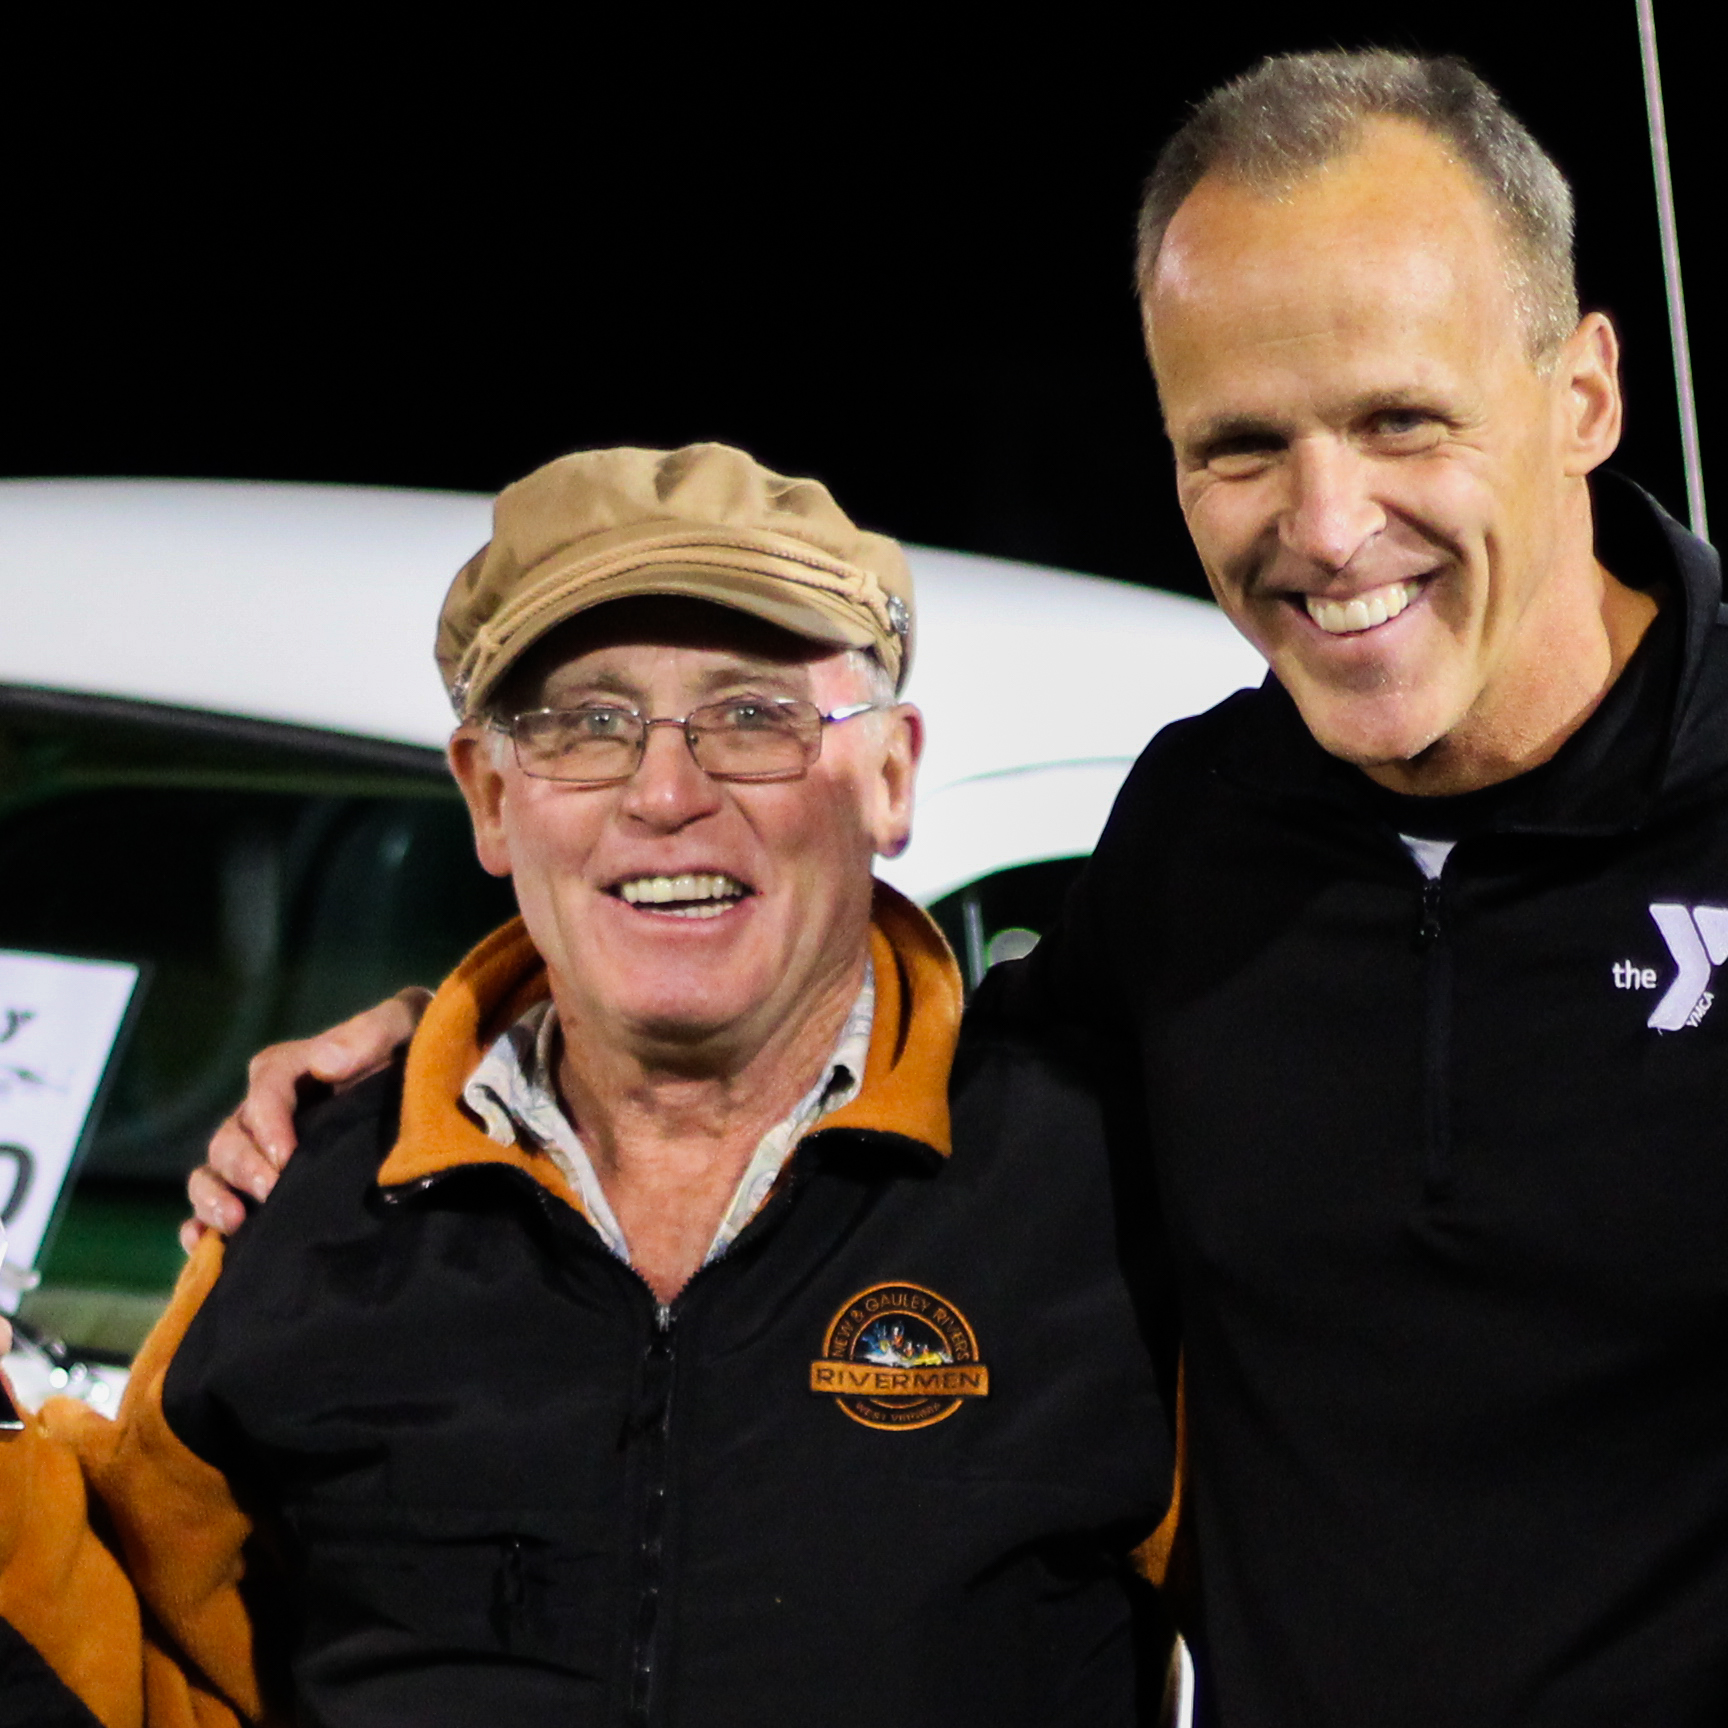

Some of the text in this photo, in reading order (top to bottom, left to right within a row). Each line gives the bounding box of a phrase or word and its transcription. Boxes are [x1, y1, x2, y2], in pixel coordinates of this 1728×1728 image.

[1612, 959, 1657, 990] the
[1685, 991, 1715, 1028] YMCA
[831, 1292, 970, 1361] NEW & GAULEY RIVERS
[815, 1367, 981, 1390] RIVERMEN
[855, 1401, 887, 1421] WEST
